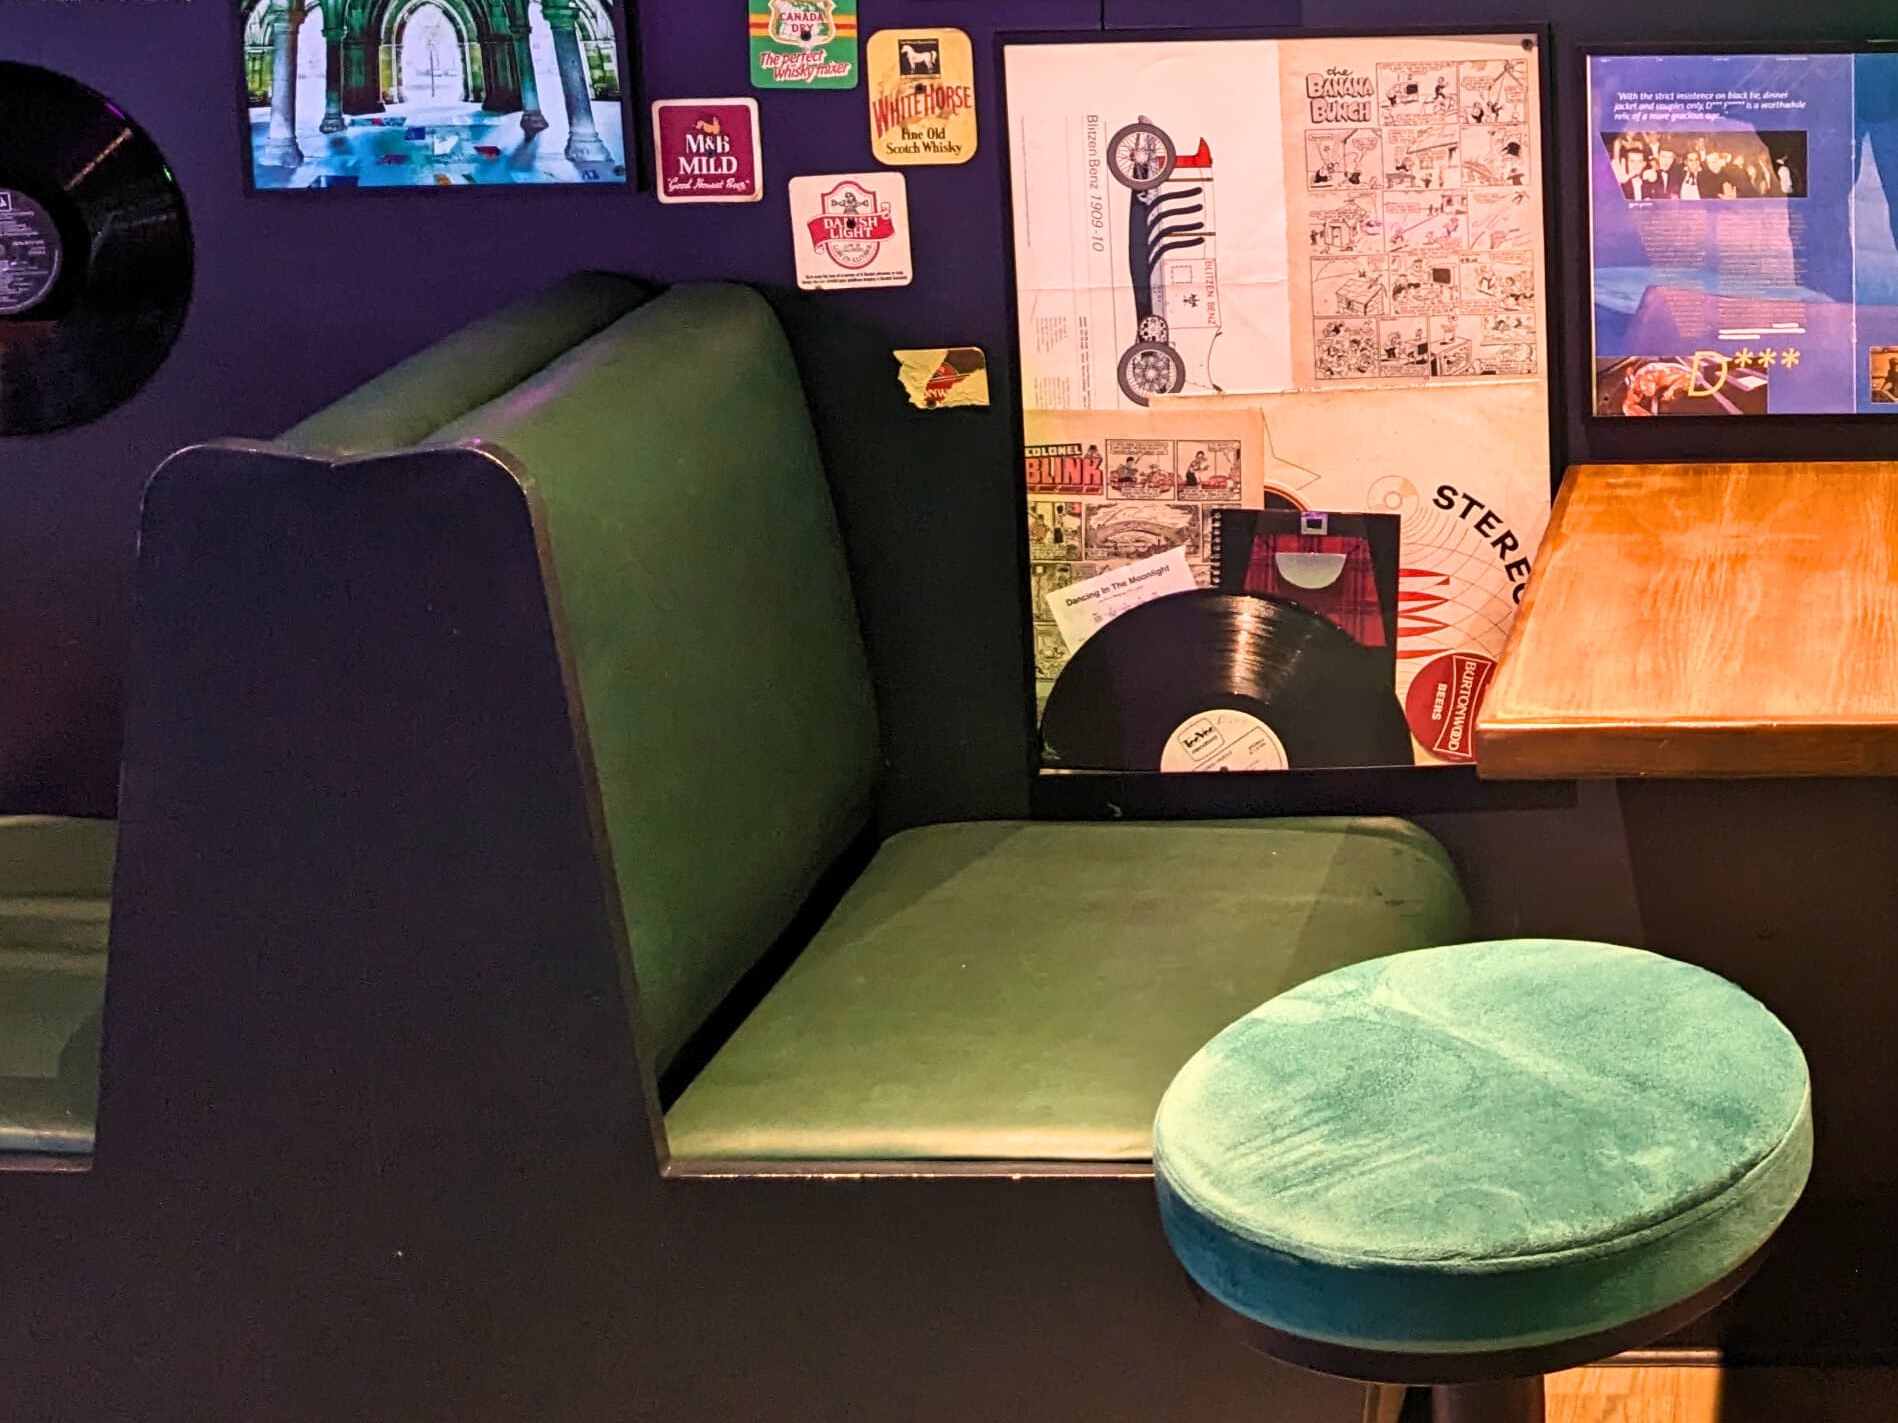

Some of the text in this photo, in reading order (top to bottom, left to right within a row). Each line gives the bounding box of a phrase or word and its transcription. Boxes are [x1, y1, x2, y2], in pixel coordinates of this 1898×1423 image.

[779, 11, 824, 23] CANADA
[1304, 73, 1375, 100] BANANA
[1309, 99, 1373, 125] BUNCH
[684, 134, 731, 155] M&B
[678, 154, 739, 176] MILD
[829, 227, 874, 240] LIGHT
[1025, 443, 1082, 457] COLONEL
